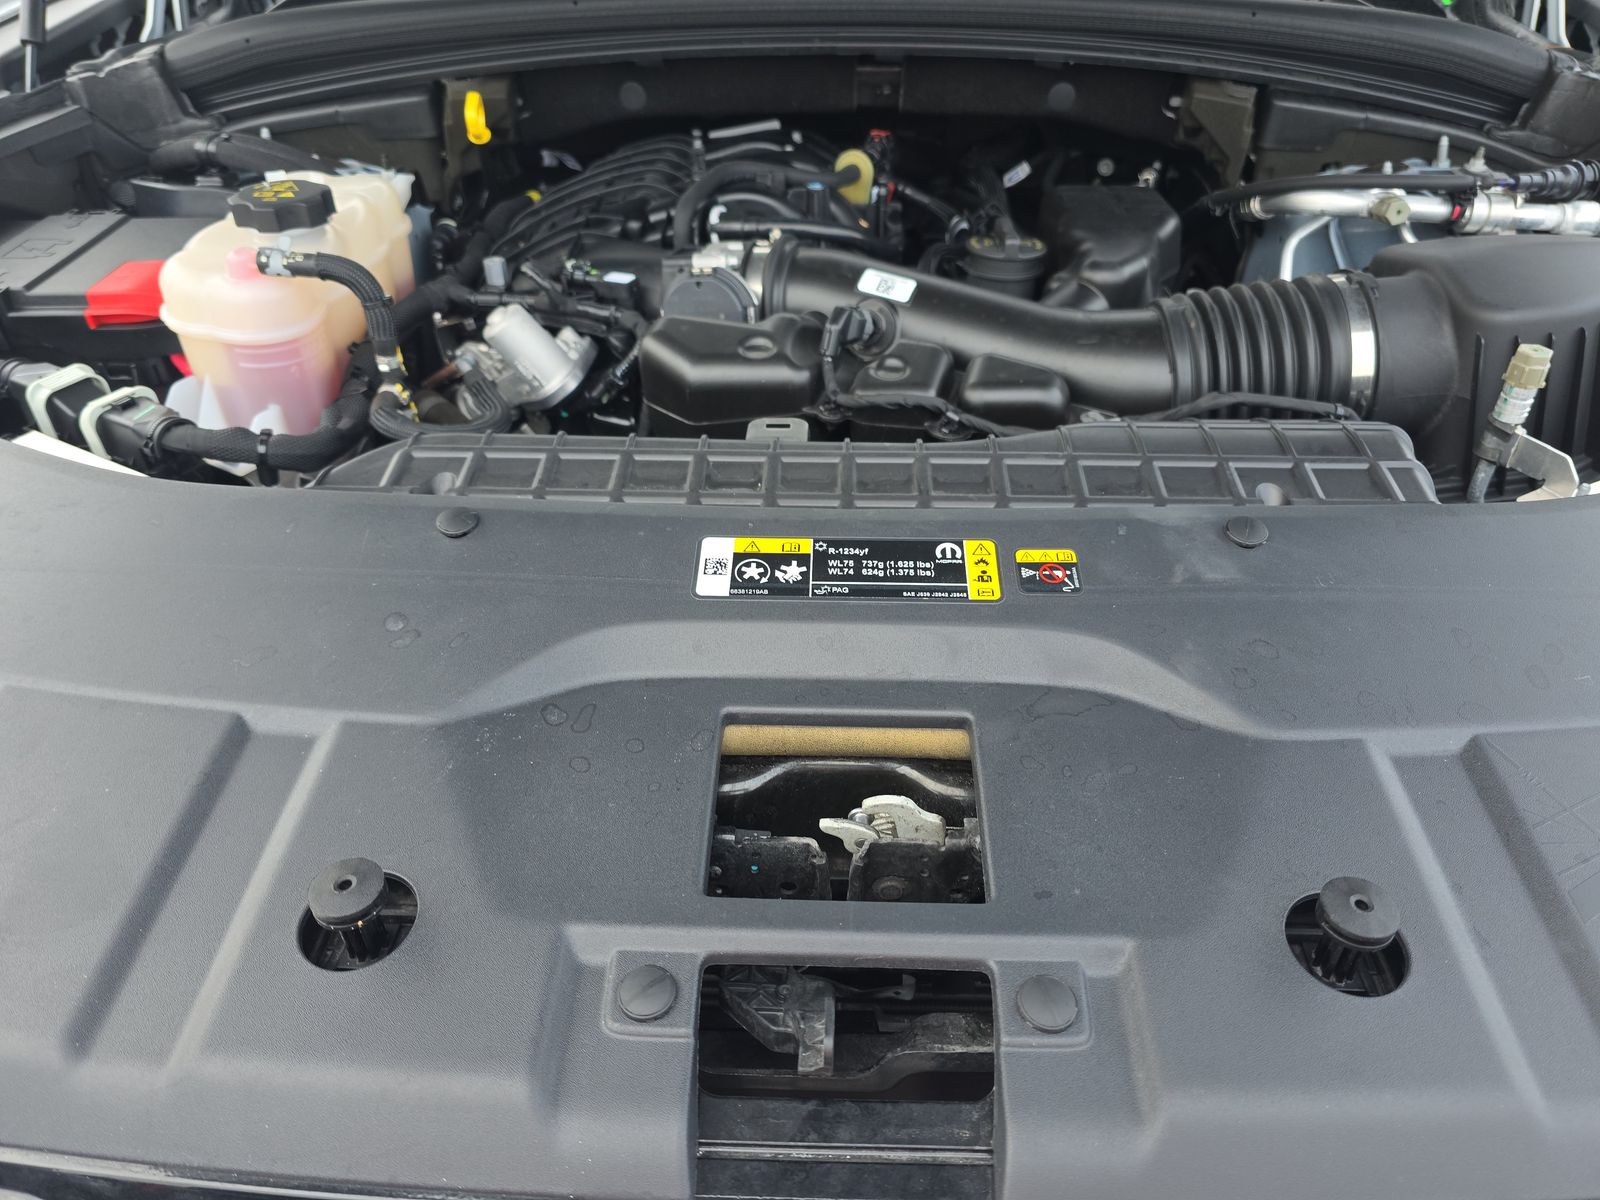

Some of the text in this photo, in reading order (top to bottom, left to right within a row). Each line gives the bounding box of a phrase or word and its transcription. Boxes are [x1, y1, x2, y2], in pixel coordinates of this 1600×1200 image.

[828, 548, 869, 556] R-1234yf
[862, 560, 884, 569] 737g
[886, 560, 914, 569] (1.625
[916, 560, 934, 569] lbs)
[862, 568, 884, 577] 624g
[886, 568, 915, 577] (1.375
[916, 569, 935, 578] lbs)
